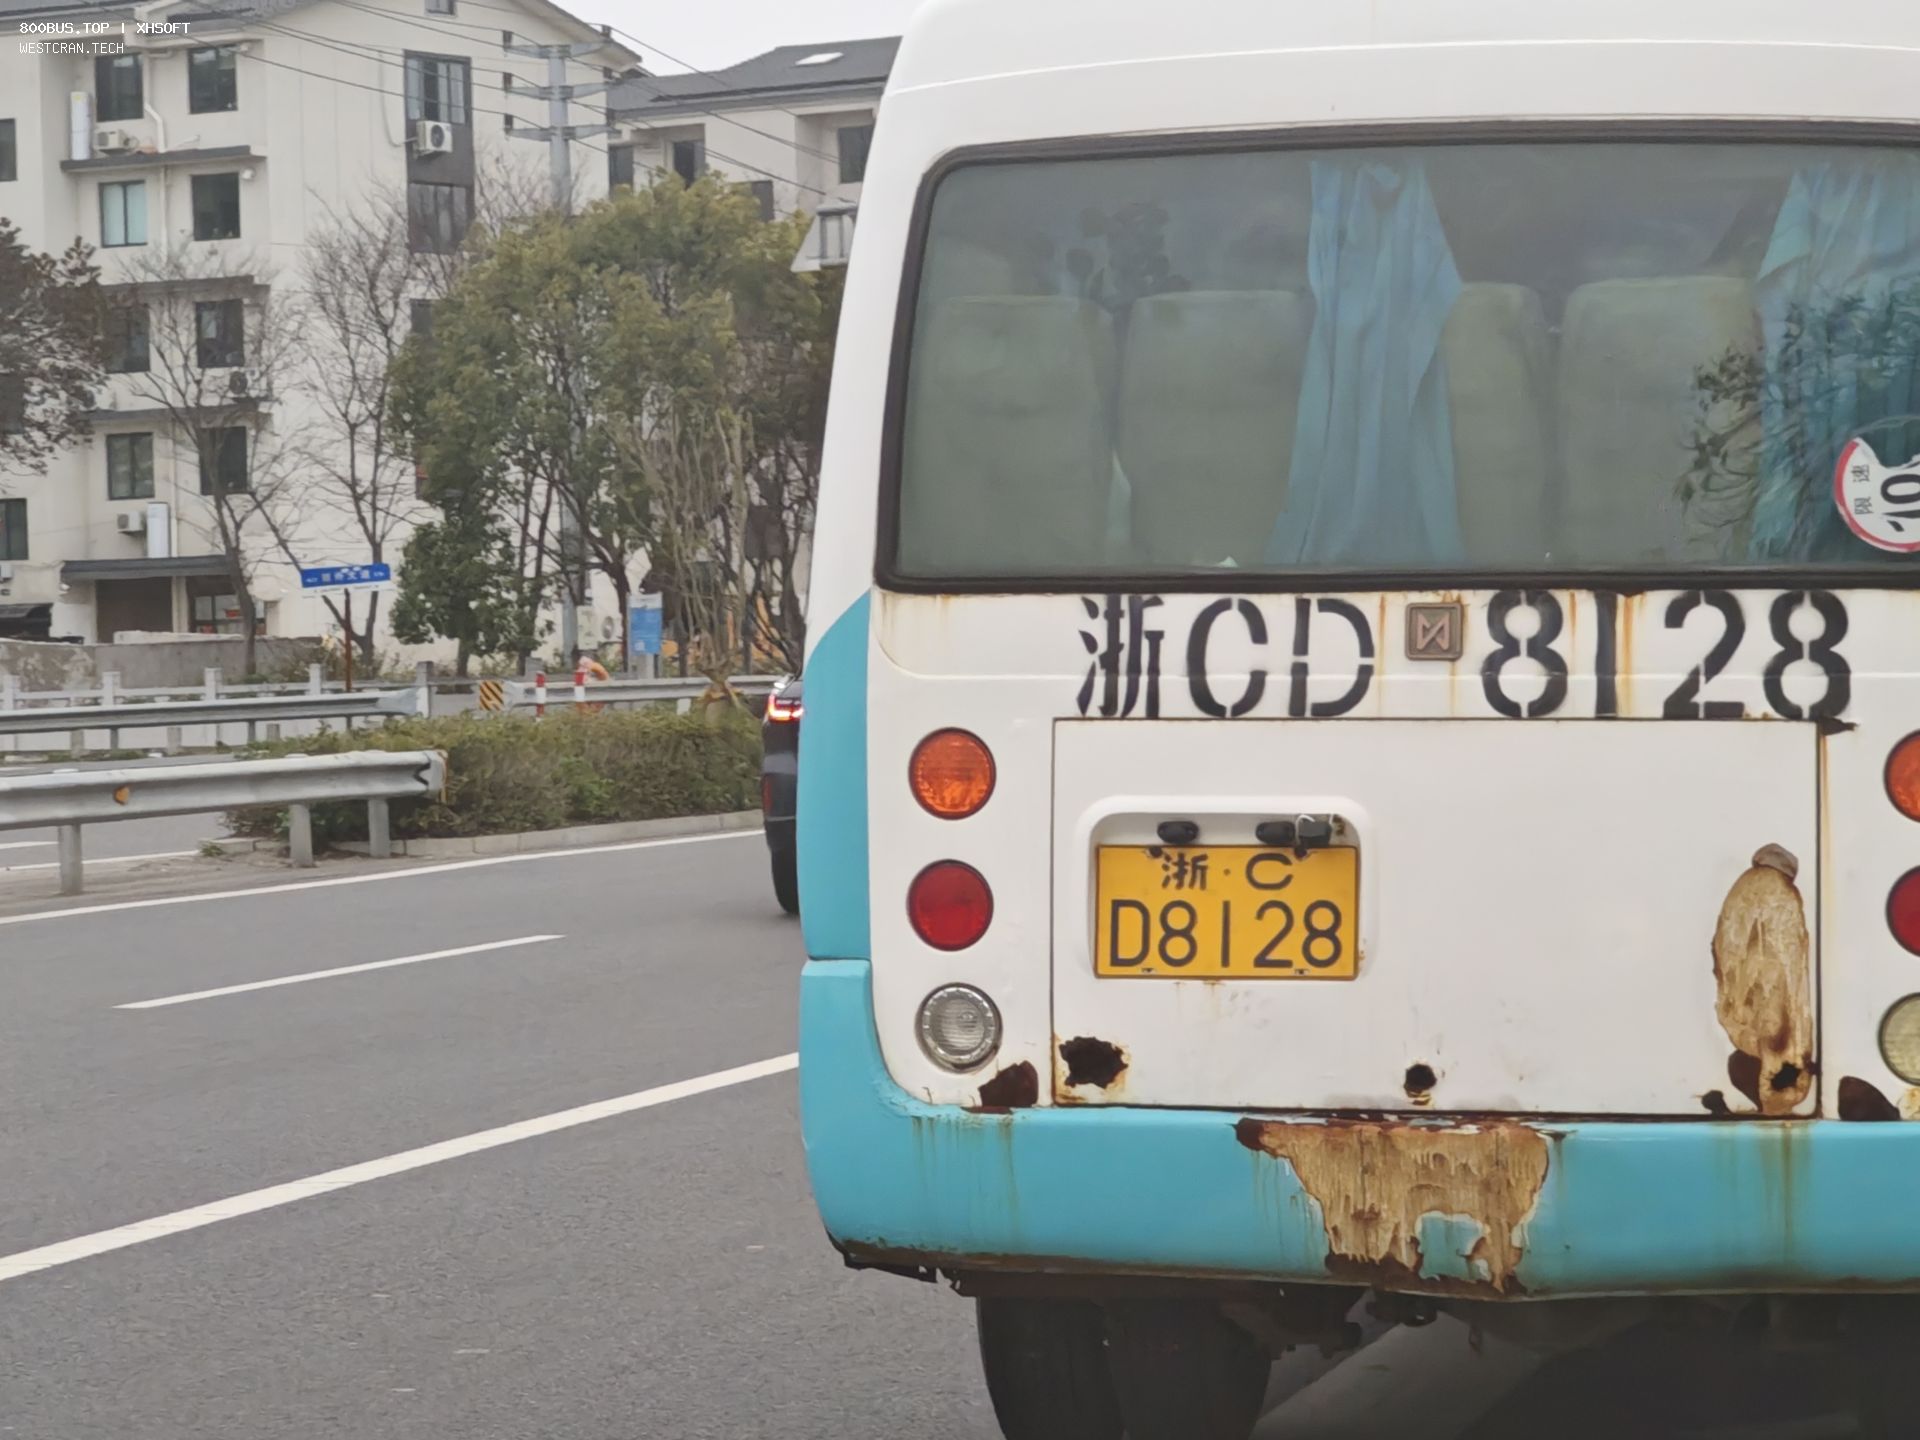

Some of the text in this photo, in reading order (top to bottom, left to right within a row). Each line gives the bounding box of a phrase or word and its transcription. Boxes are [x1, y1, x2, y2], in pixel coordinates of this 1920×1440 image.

[1851, 463, 1874, 515] 限速
[1880, 458, 1920, 532] 10
[1109, 899, 1343, 968] D8128
